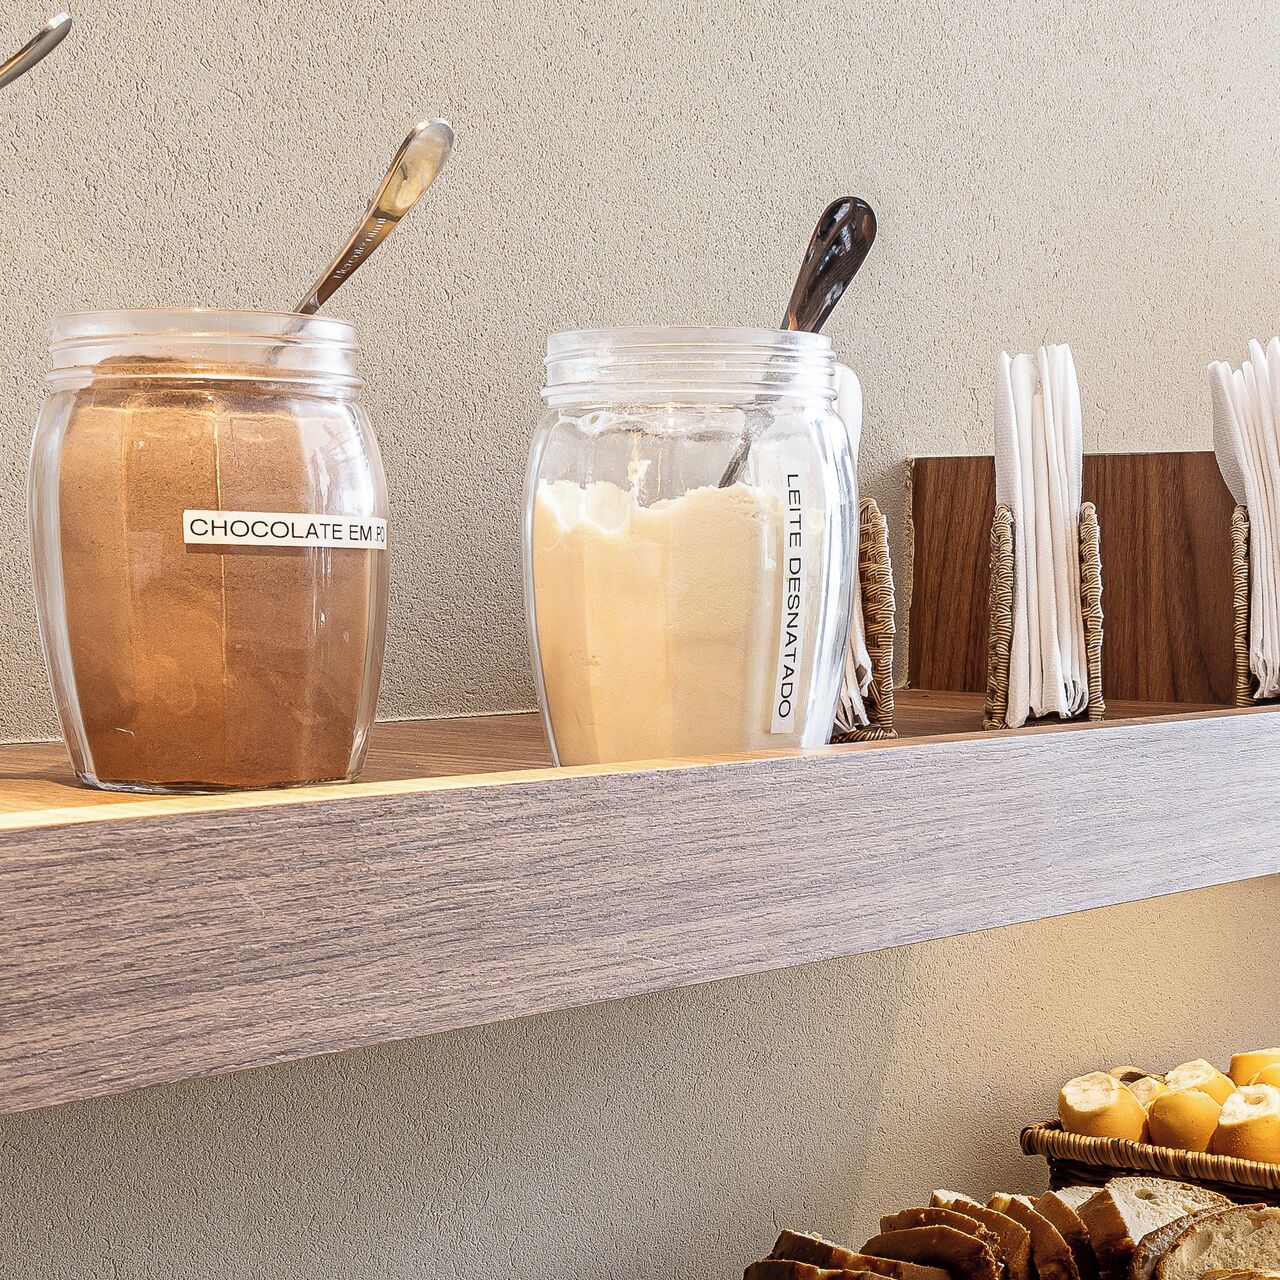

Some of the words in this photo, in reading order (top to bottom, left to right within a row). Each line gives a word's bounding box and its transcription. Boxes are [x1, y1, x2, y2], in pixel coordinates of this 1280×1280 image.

[189, 518, 343, 541] CHOCOLATE
[349, 524, 372, 541] EM
[786, 473, 802, 548] LEITE
[777, 558, 802, 719] DESNATADO
